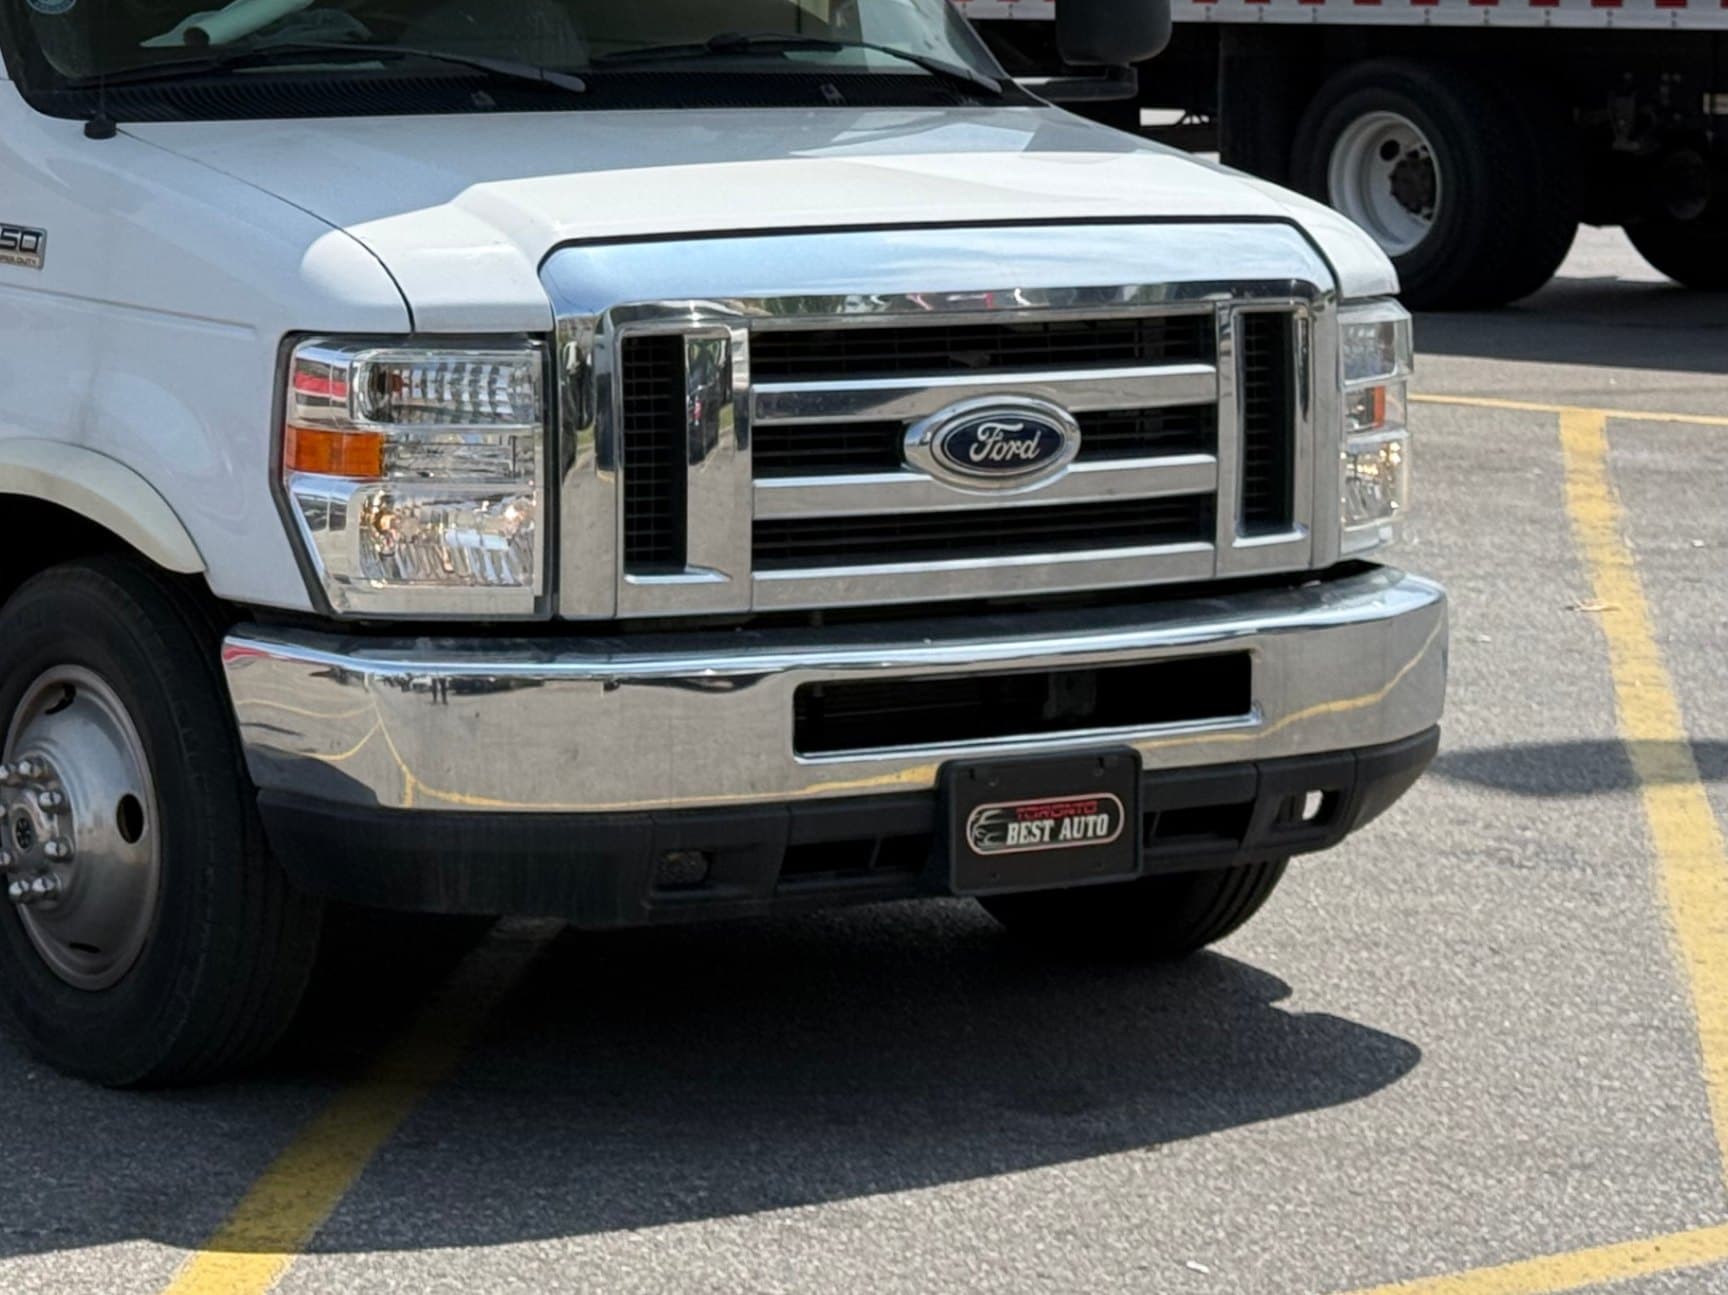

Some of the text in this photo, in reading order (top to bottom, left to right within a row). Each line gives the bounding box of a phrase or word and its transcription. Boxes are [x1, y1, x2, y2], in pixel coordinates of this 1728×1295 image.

[969, 422, 1041, 462] Ford
[1016, 801, 1098, 820] TORONTO
[1006, 813, 1109, 845] BEST AUTO
